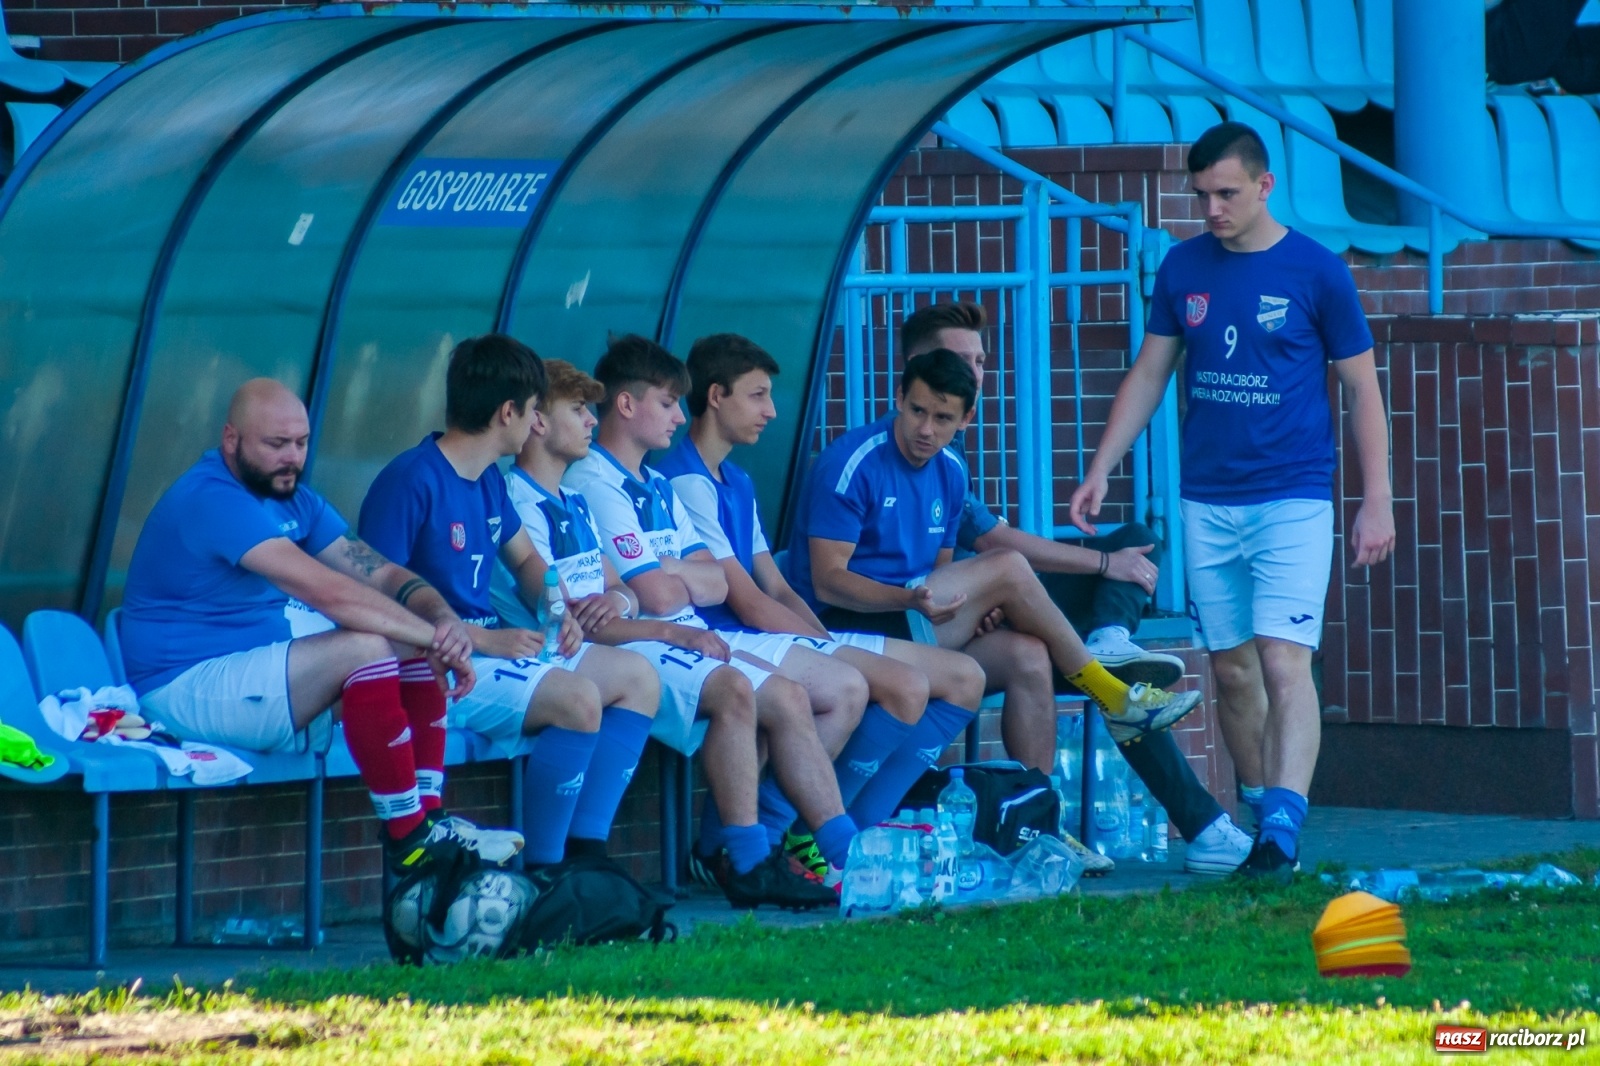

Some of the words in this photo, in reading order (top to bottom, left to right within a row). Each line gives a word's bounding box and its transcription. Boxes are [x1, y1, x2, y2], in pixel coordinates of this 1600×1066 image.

[397, 169, 547, 212] GOSPODARZE
[1224, 324, 1238, 359] 9
[1220, 372, 1268, 388] RACIBÓRZ
[471, 554, 484, 588] 7
[660, 645, 704, 670] 13
